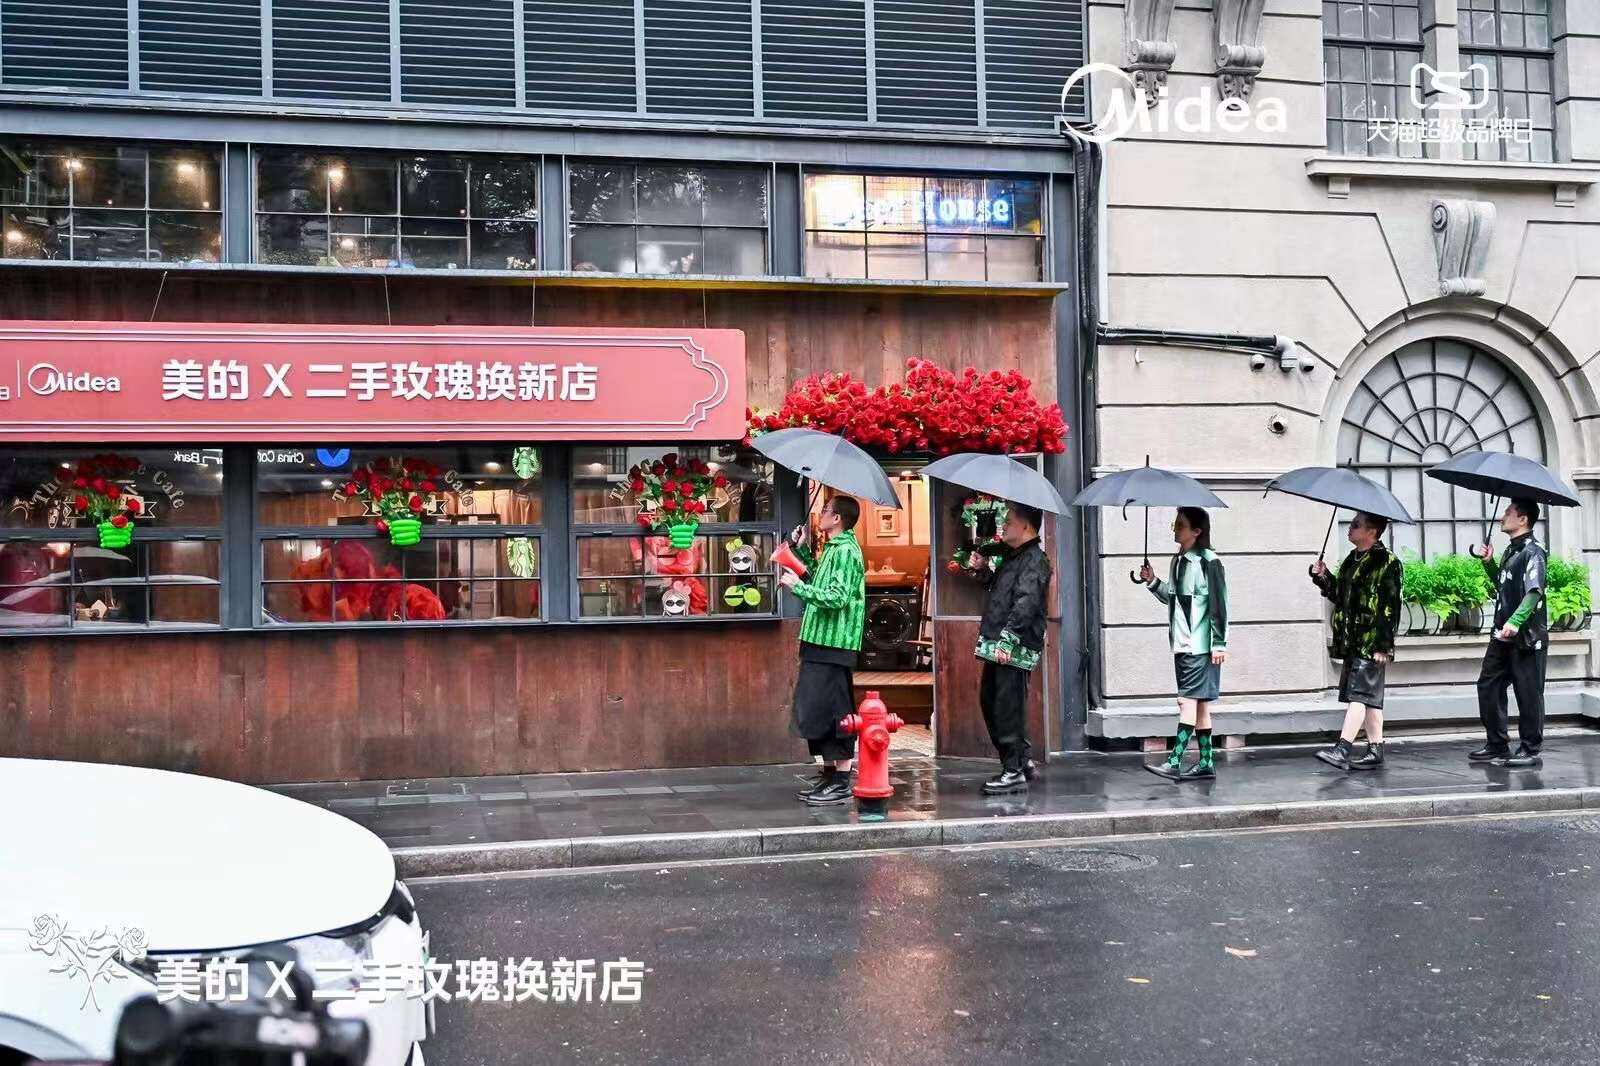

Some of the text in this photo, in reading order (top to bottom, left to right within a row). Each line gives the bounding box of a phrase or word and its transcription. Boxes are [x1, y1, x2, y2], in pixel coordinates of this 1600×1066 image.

[28, 363, 121, 395] Midea
[162, 359, 249, 401] 美的
[305, 361, 599, 401] 二手玫瑰换新店
